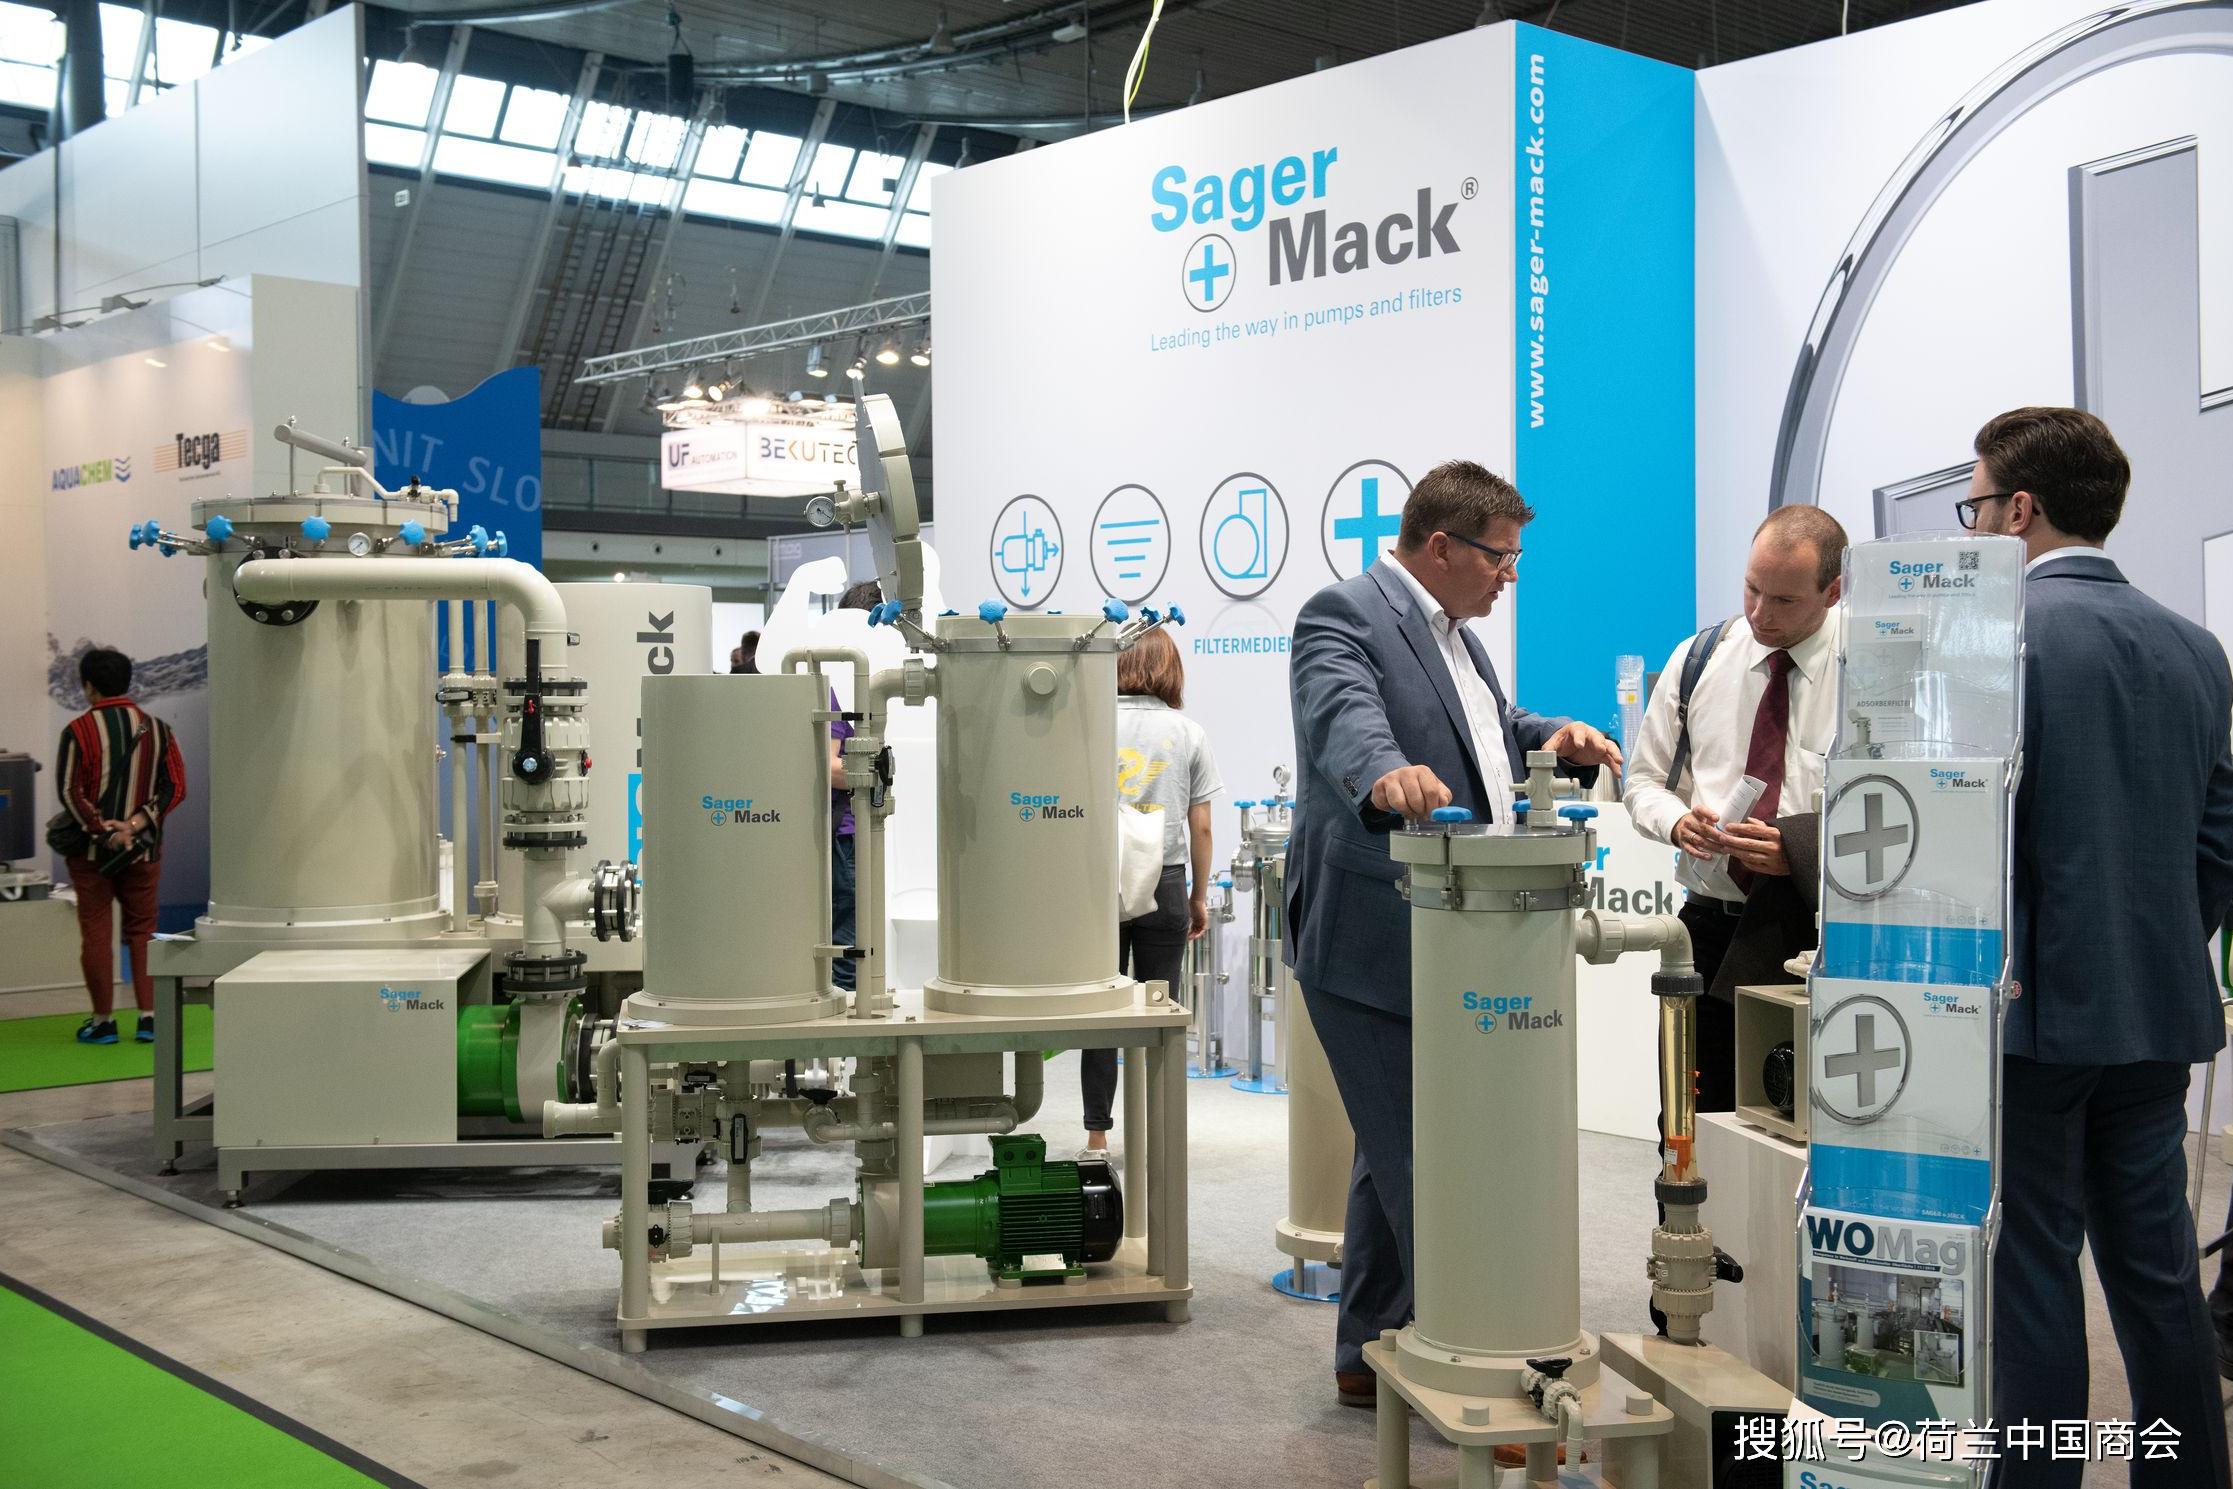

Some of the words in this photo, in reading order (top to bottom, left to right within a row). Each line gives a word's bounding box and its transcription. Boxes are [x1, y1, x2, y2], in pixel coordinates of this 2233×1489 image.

[1151, 146, 1338, 232] Sager
[1526, 53, 1549, 429] www.sager-mack.com
[1151, 328, 1211, 352] Leading
[1216, 321, 1240, 342] the
[1246, 316, 1278, 337] way
[1284, 311, 1299, 330] in
[1304, 303, 1364, 330] pumps
[1370, 294, 1402, 316] and
[1409, 287, 1462, 310] filters
[669, 443, 690, 468] UF
[52, 459, 112, 491] AQUACHEM
[1890, 560, 1943, 577] Sager
[1923, 574, 1975, 589] Mack
[1875, 620, 1900, 629] Sager
[1890, 626, 1914, 635] Mack
[1930, 768, 1966, 780] Sager
[1952, 778, 1986, 788] Mack
[702, 795, 753, 812] Sager
[1010, 792, 1060, 808] Sager
[734, 809, 781, 823] Mack
[1042, 805, 1084, 819] Mack
[379, 988, 422, 1001] Sager
[1923, 992, 1959, 1004] Sager
[406, 999, 445, 1010] Mack
[1463, 991, 1533, 1015] Sager
[1945, 1003, 1979, 1014] Mack
[1508, 1010, 1564, 1030] Mack
[1806, 1215, 1966, 1276] WOMag
